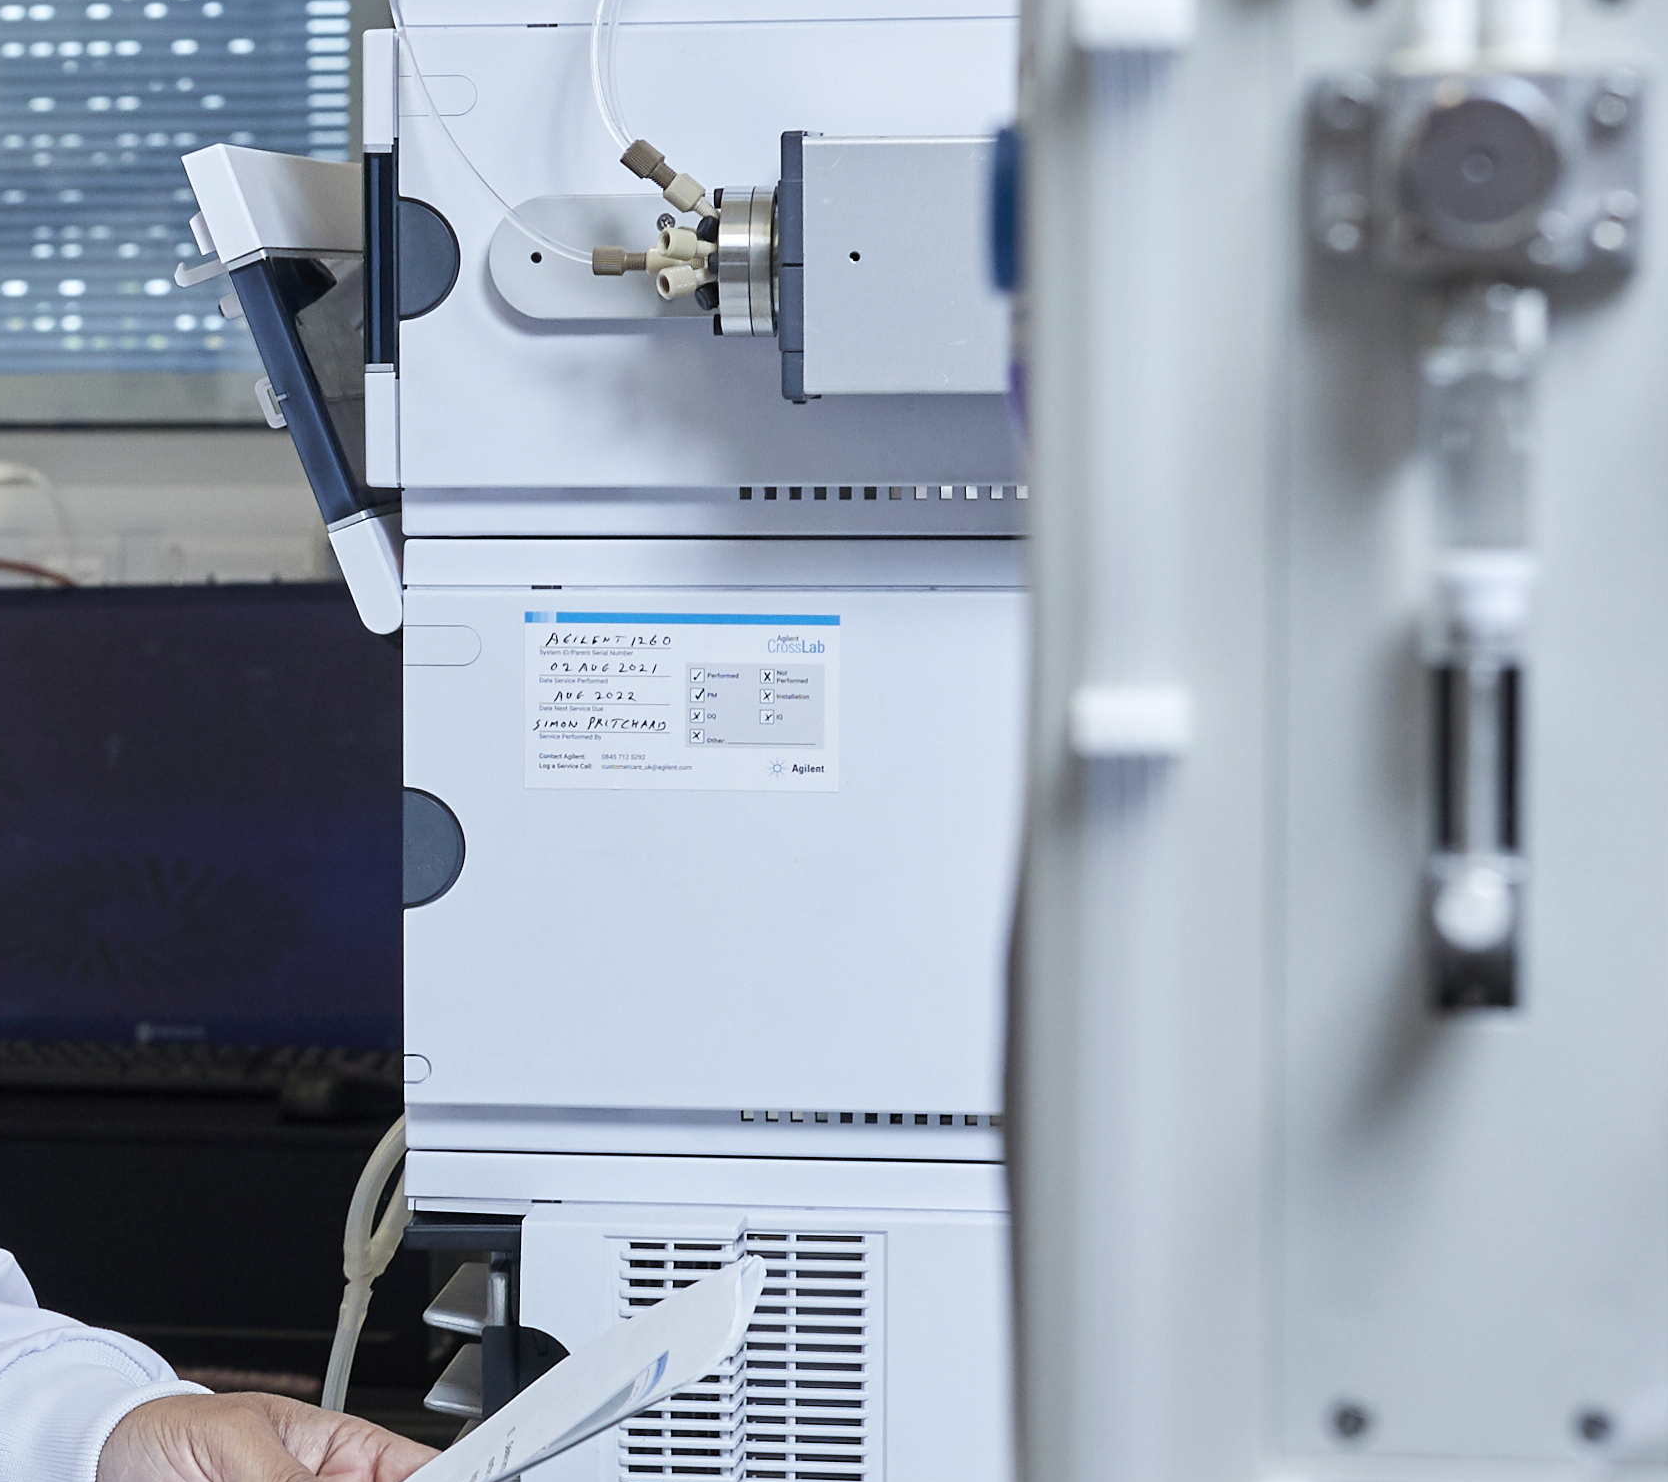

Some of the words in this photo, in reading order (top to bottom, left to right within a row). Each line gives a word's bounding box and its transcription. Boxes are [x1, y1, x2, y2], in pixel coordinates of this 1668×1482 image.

[630, 634, 671, 647] 1260
[777, 635, 799, 643] Agilent
[767, 639, 825, 654] CrossLab
[550, 662, 573, 672] 02
[578, 663, 609, 673] AUG
[618, 663, 658, 674] 2021
[595, 691, 637, 702] 2022
[533, 719, 578, 731] SIMON
[586, 716, 667, 731] PRITCHARD
[791, 764, 825, 775] Agilent
